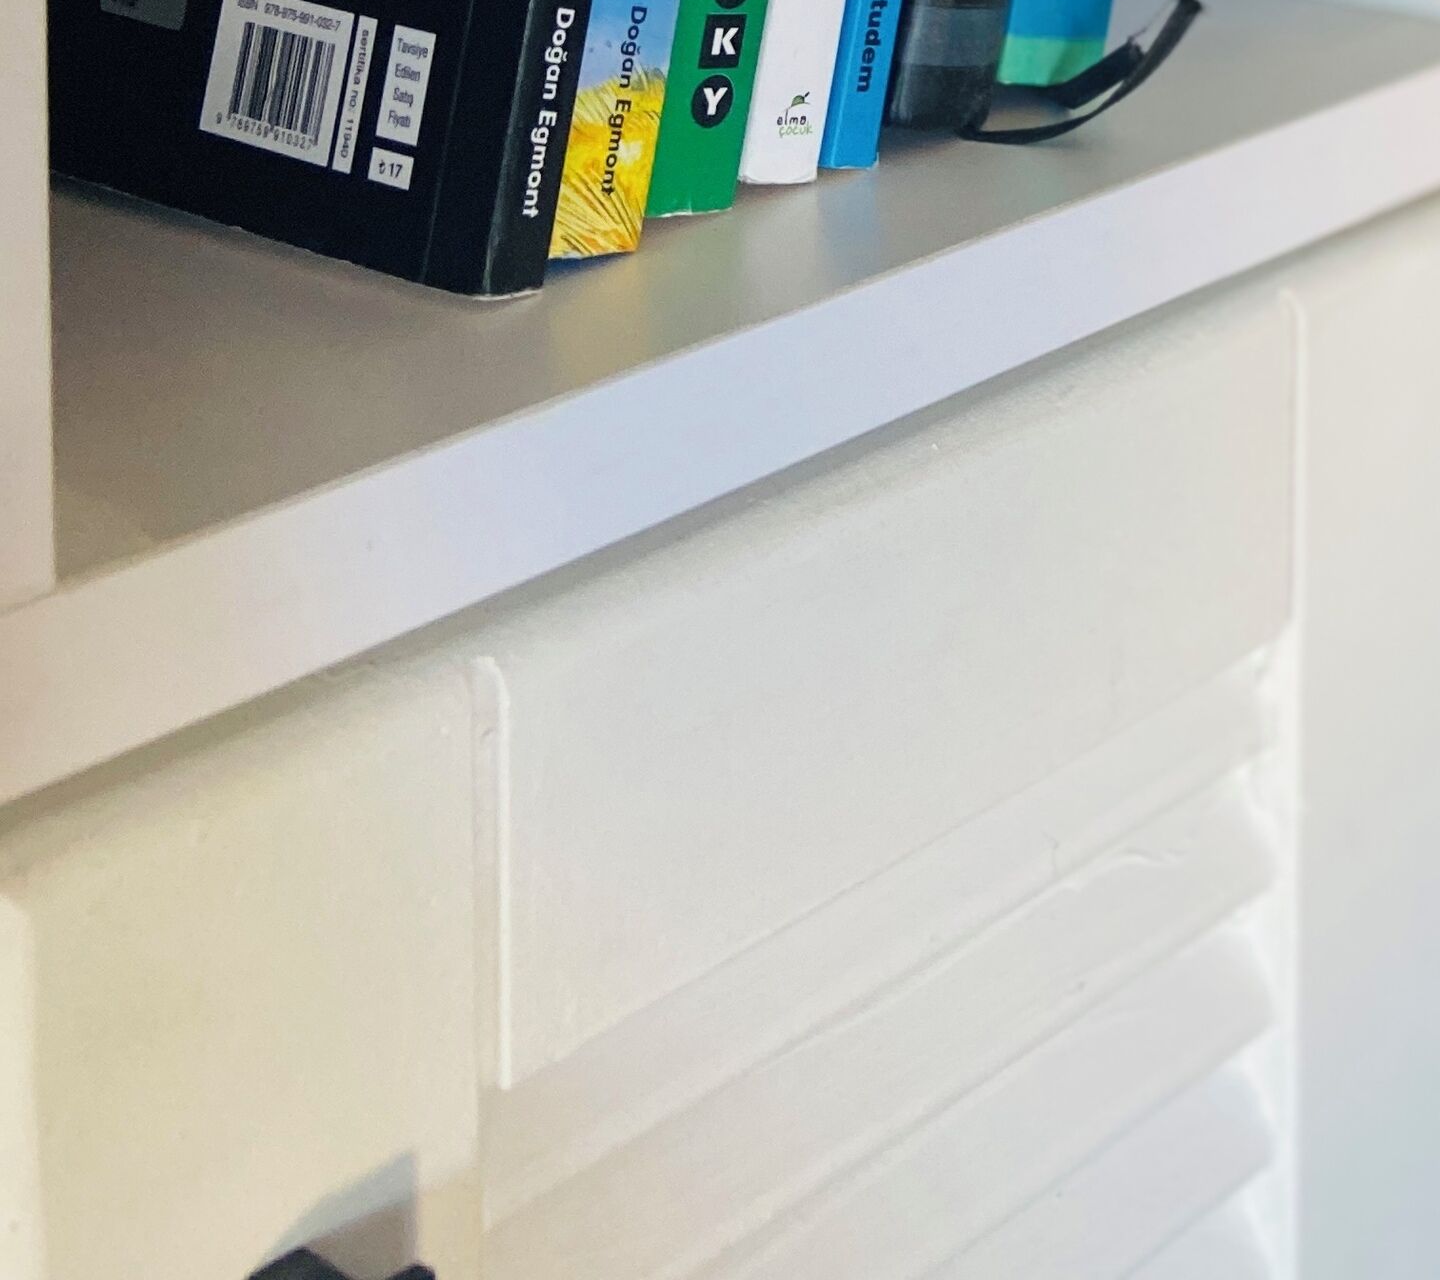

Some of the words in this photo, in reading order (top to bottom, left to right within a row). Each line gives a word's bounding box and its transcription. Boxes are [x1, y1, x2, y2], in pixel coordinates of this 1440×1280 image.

[541, 7, 575, 100] Doğan
[619, 5, 648, 88] Doğan
[602, 99, 632, 197] Egmont
[776, 108, 807, 125] elma
[522, 110, 558, 218] Egmont
